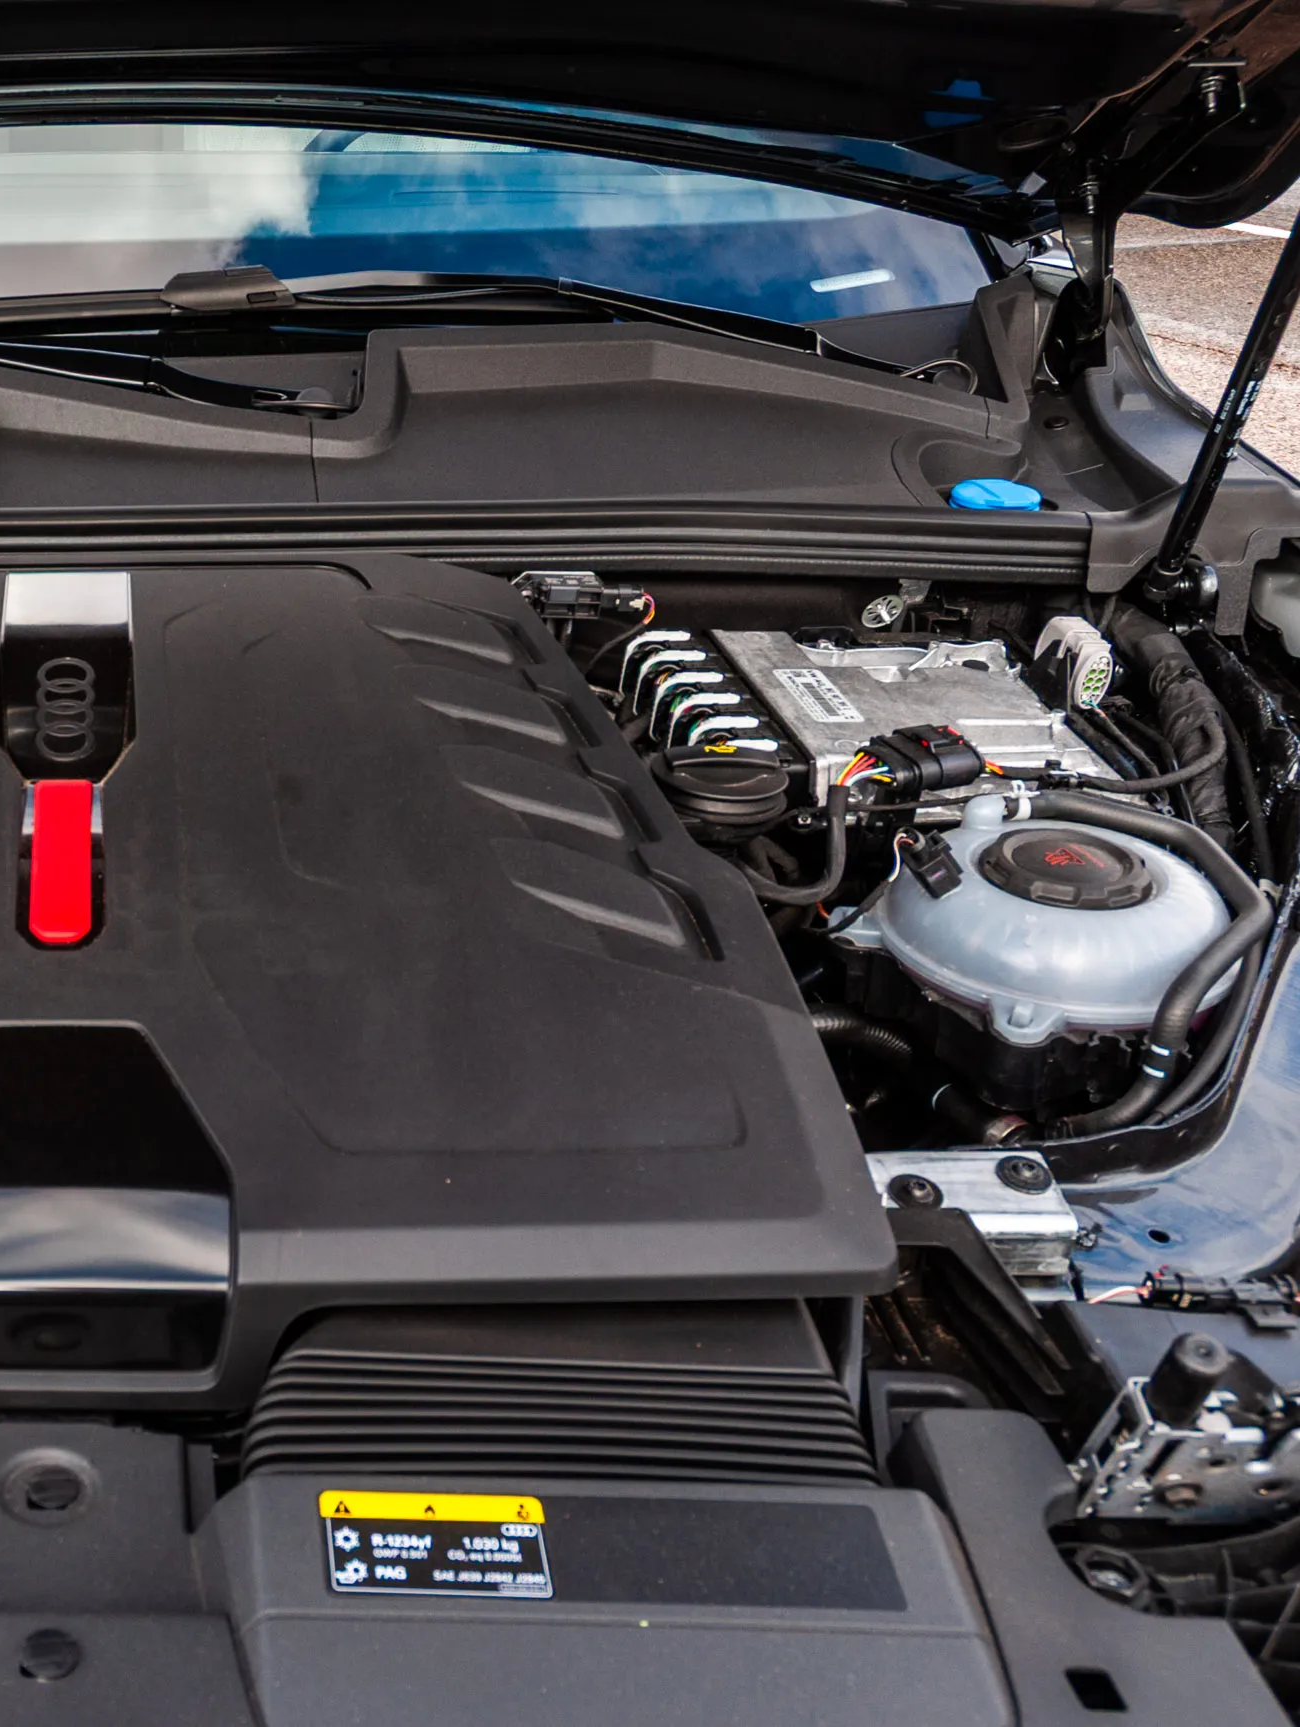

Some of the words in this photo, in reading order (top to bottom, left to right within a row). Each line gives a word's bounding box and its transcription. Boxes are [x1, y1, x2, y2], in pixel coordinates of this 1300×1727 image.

[369, 1533, 433, 1551] R-1234yf
[501, 1537, 520, 1553] kg
[373, 1565, 408, 1581] PAG
[432, 1569, 456, 1582] SAE
